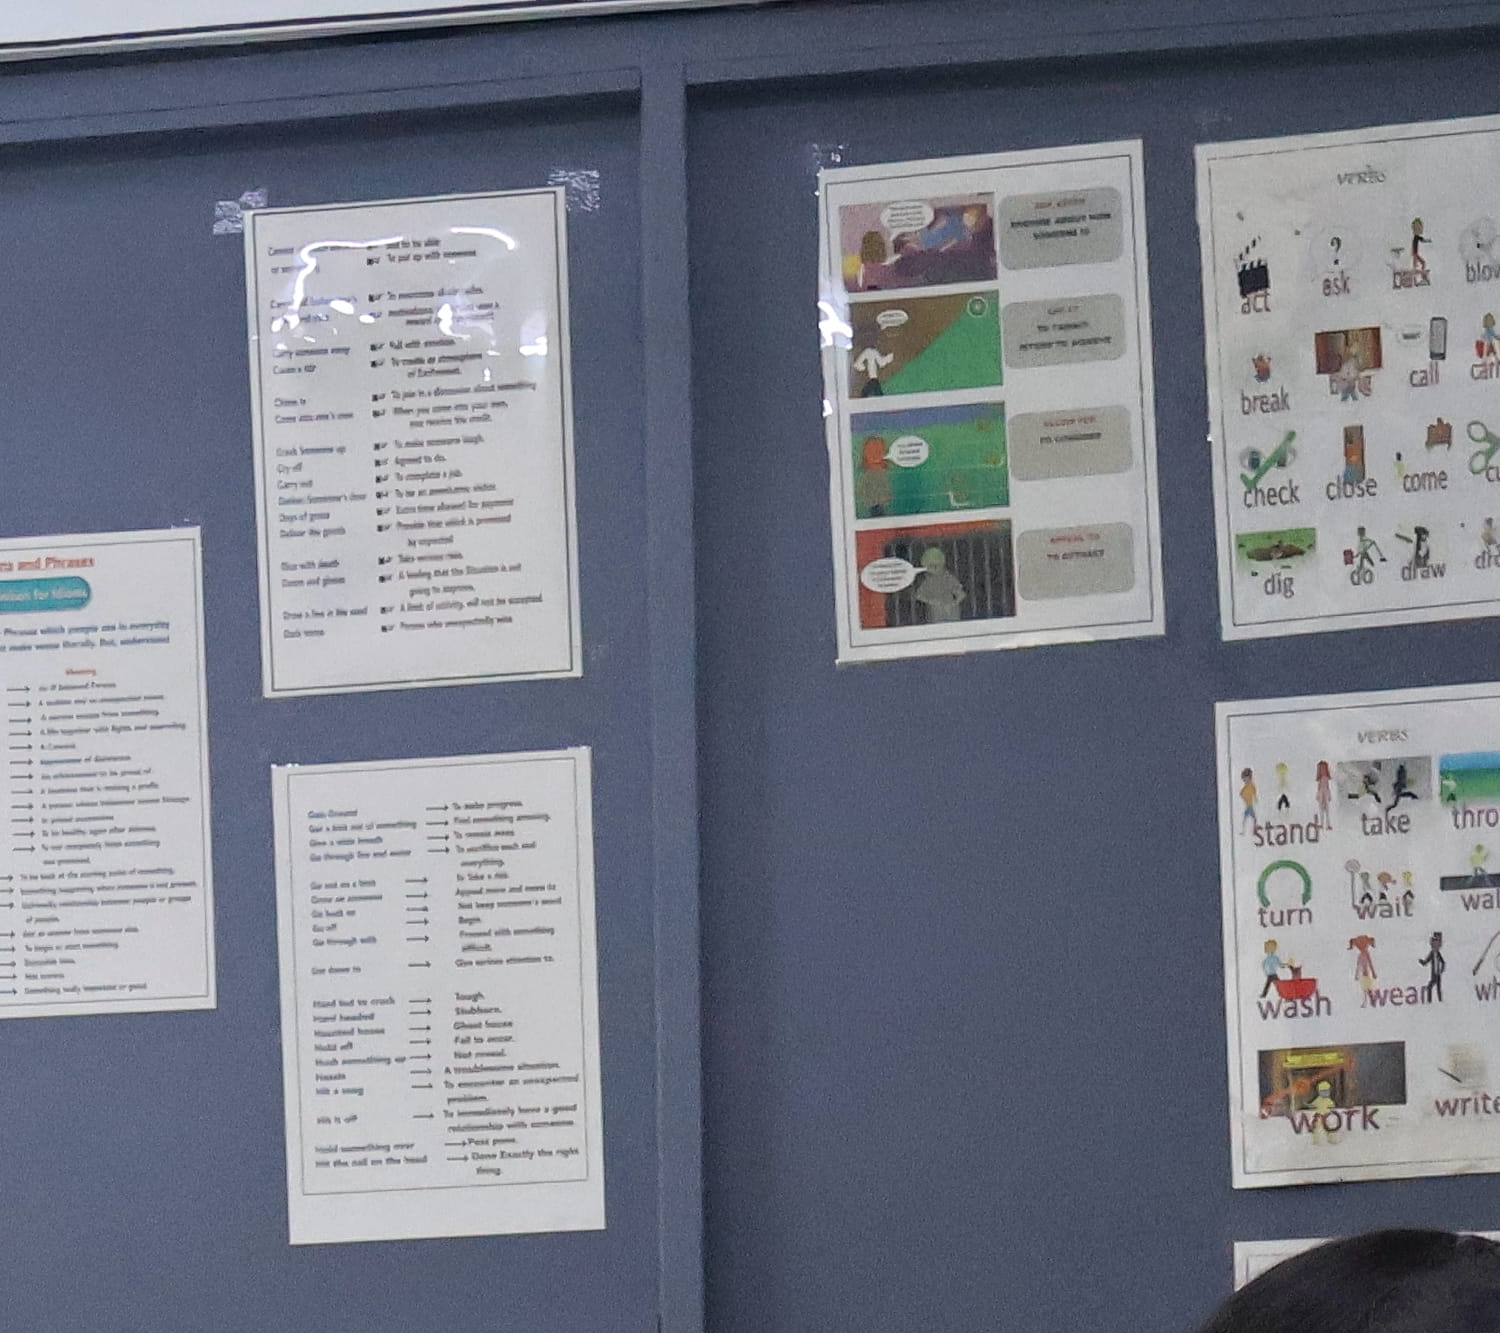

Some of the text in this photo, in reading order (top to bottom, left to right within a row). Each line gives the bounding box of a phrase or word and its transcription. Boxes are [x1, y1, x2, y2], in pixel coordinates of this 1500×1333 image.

[1241, 385, 1290, 415] break
[1410, 360, 1440, 388] call
[1243, 479, 1300, 509] check
[1326, 477, 1377, 500] close
[1402, 469, 1448, 494] come
[18, 559, 41, 570] and
[1264, 571, 1294, 598] dig
[1351, 566, 1373, 586] do
[1401, 560, 1446, 582] draw
[1253, 813, 1321, 846] stand
[1362, 811, 1411, 836] take
[1258, 905, 1312, 928] turn
[1355, 896, 1414, 920] wait
[1257, 993, 1332, 1020] wash
[1366, 985, 1431, 1008] wear
[1289, 1105, 1380, 1135] work
